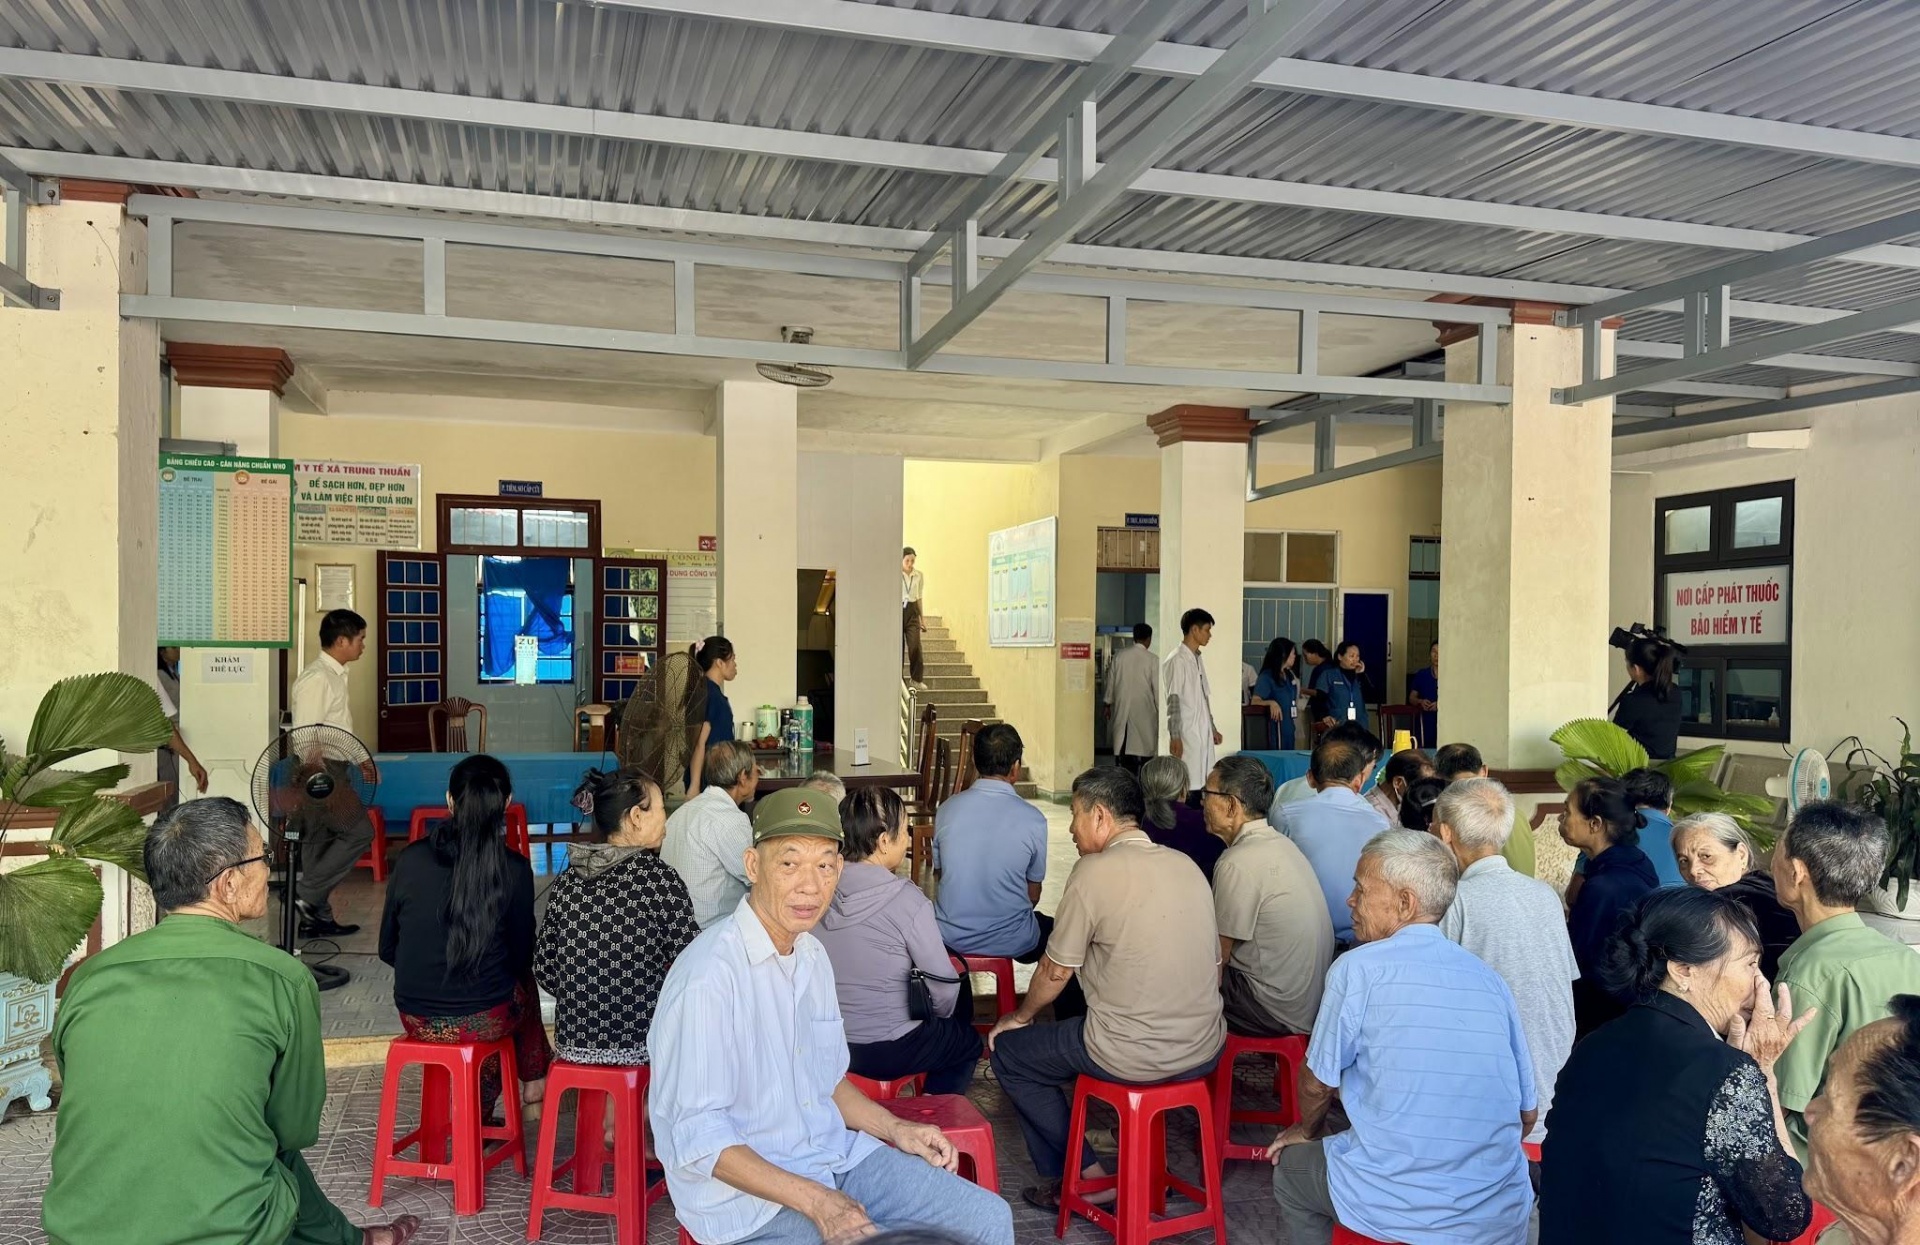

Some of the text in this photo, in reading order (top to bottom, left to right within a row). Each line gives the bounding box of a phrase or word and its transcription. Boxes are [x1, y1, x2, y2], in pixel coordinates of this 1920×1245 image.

[203, 459, 215, 467] CAO
[272, 462, 286, 470] WHO
[303, 464, 310, 472] Y
[343, 466, 376, 475] TRUNG
[322, 480, 345, 490] SẠCH
[369, 482, 386, 492] ĐẸP
[387, 482, 405, 492] HƠN
[301, 492, 312, 501] VÀ
[314, 492, 332, 502] LÀM
[335, 493, 353, 504] VIỆC
[355, 493, 375, 504] HIỆU
[395, 496, 413, 505] HƠN
[1676, 576, 1779, 606] NƠI CẤP PHÁT THUỐC
[1691, 609, 1762, 635] BẢO HIỂM Y TẾ
